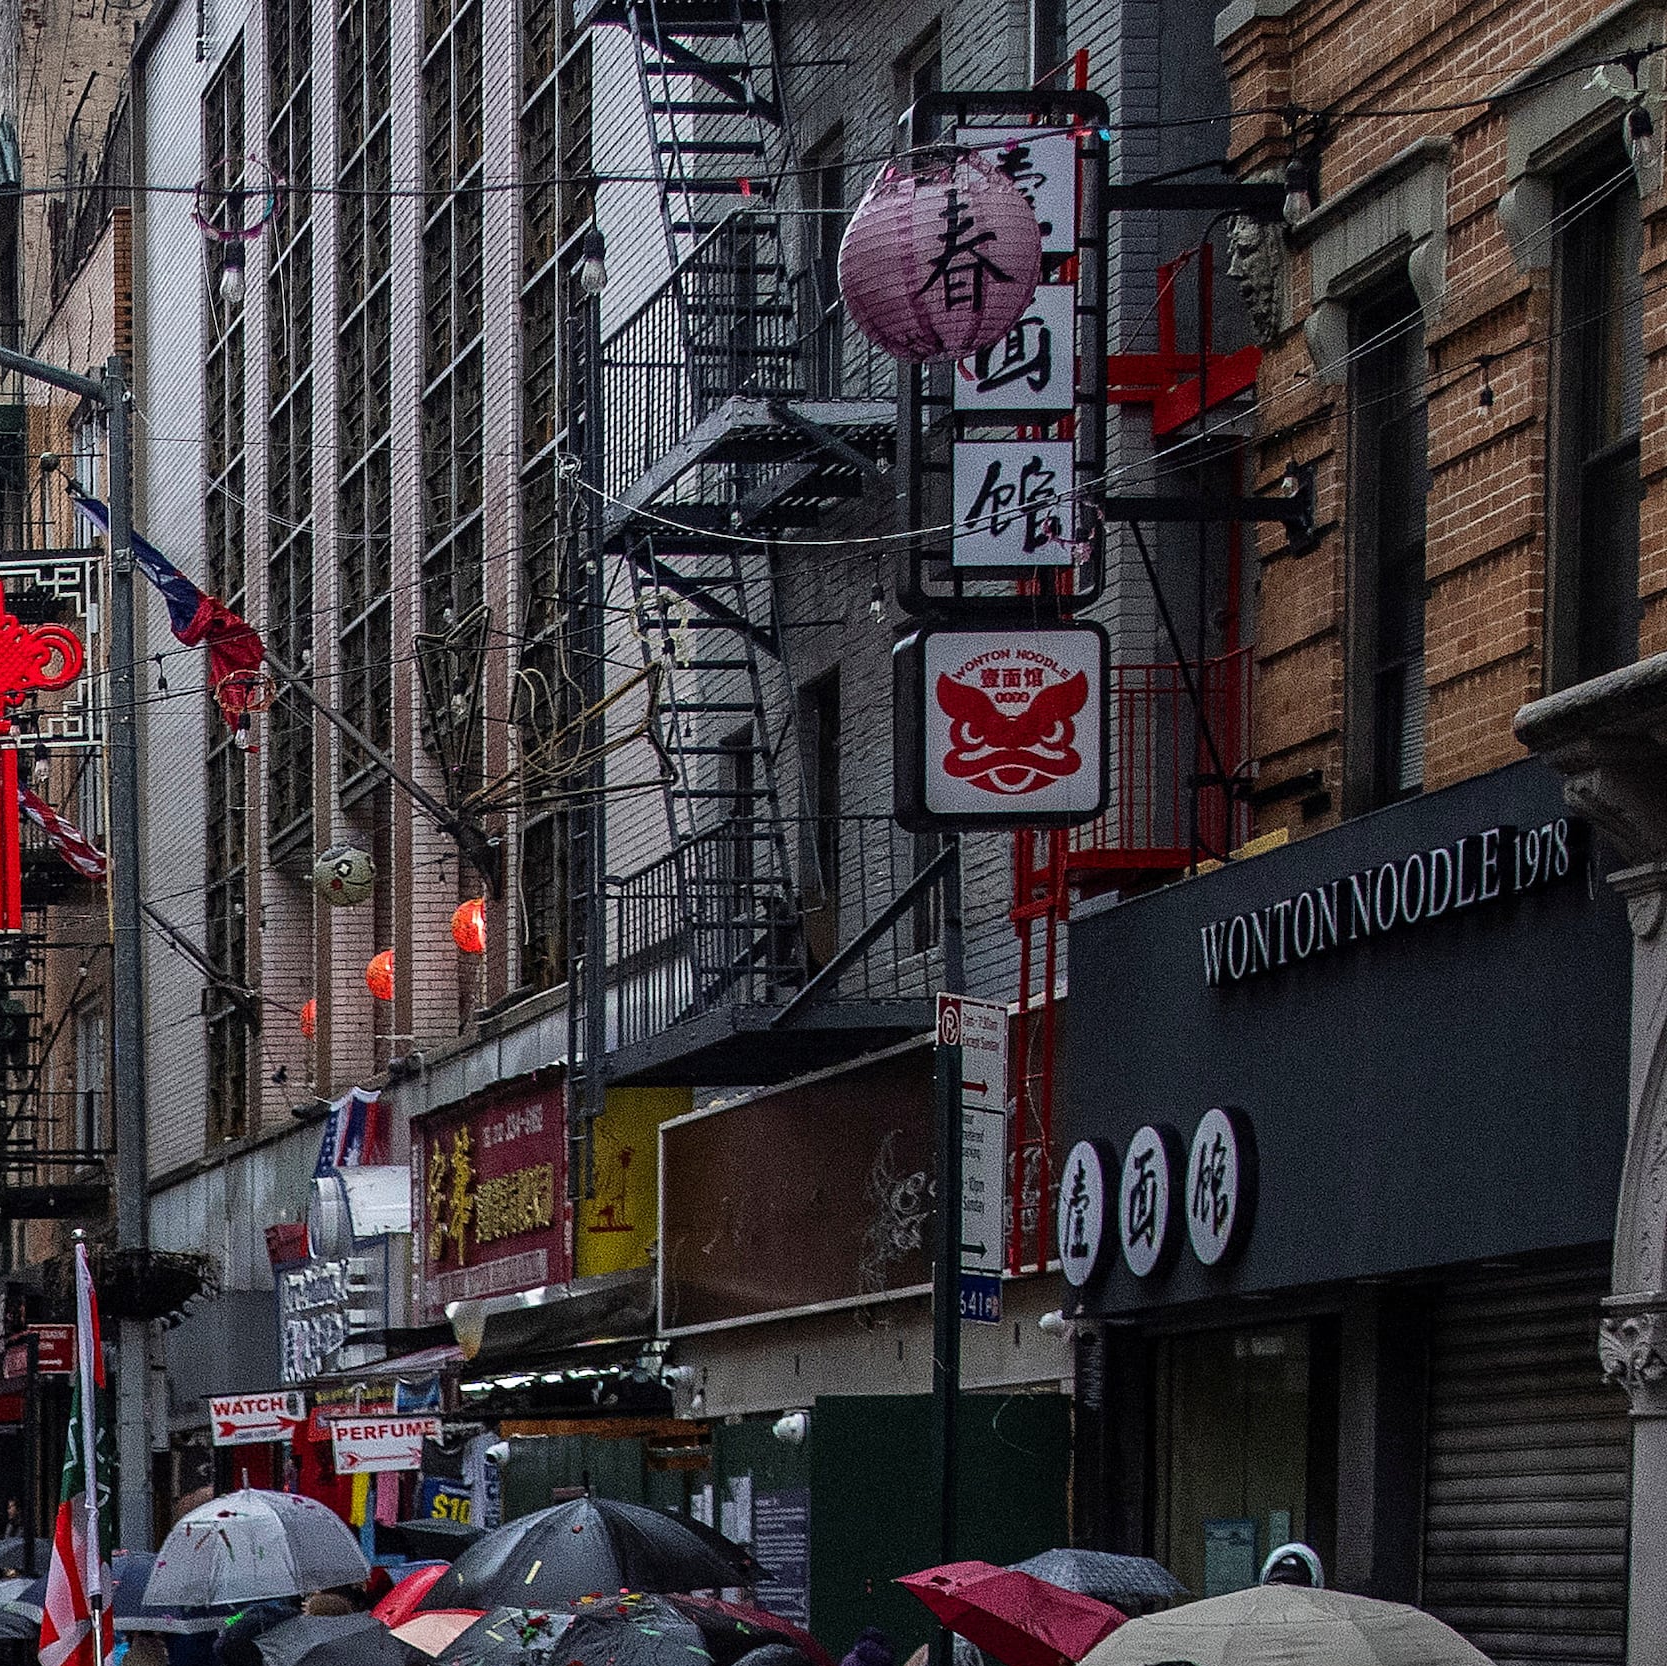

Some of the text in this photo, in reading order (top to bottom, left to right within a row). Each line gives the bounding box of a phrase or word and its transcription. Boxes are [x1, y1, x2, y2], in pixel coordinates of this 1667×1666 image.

[913, 189, 1016, 312] 春
[952, 650, 1071, 681] WONTON NOODLE
[1200, 817, 1569, 986] WONTON NOODLE 1978
[213, 1397, 285, 1418] WATCH
[336, 1420, 436, 1441] PERFUME
